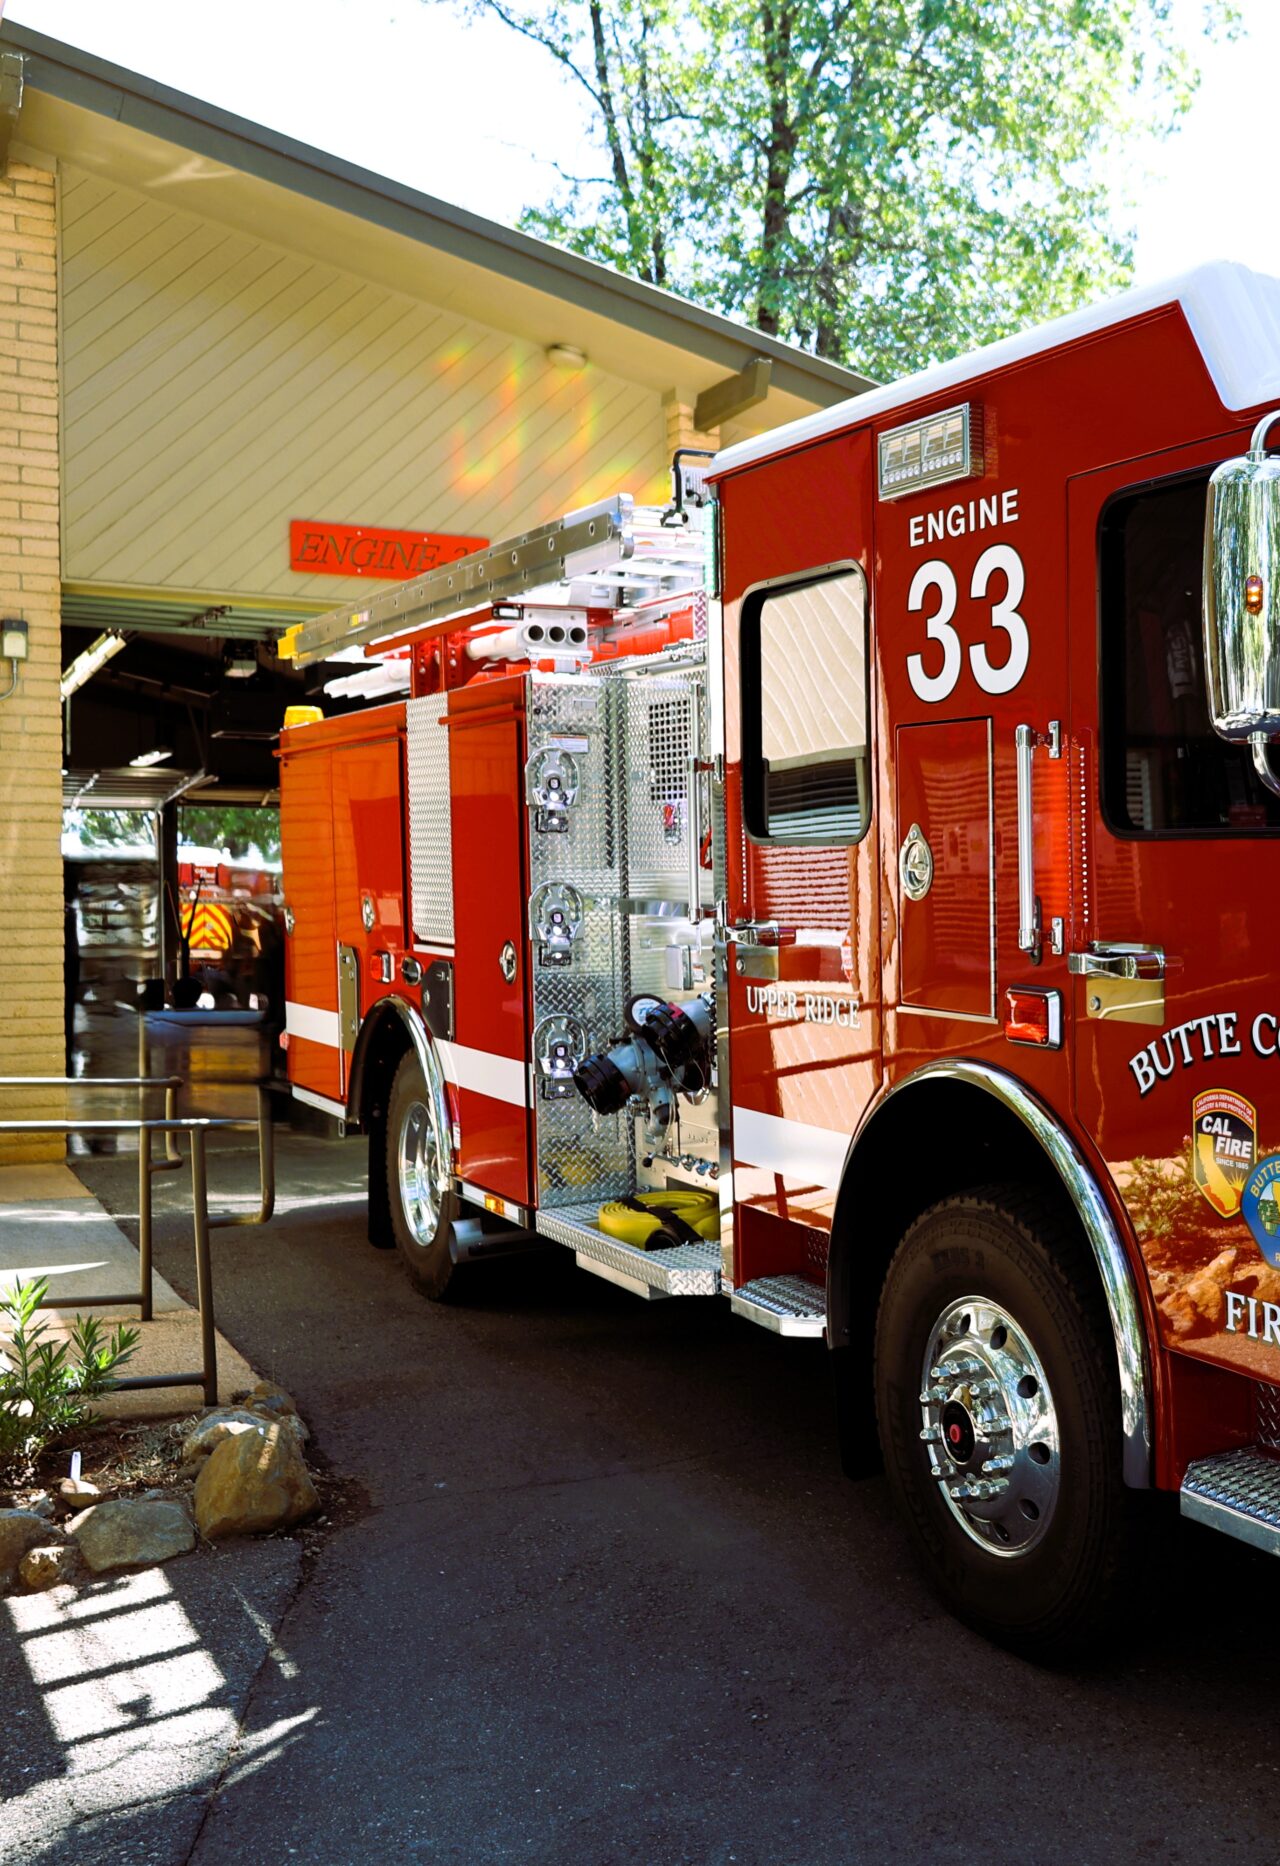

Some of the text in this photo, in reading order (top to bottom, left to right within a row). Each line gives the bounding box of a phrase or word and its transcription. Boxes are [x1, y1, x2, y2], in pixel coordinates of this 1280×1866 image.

[908, 488, 1020, 548] ENGINE
[905, 543, 1031, 704] 33
[746, 985, 861, 1030] UPPER RIDGE
[1129, 1011, 1242, 1096] BUTTE
[1202, 1115, 1232, 1136] CAL
[1215, 1136, 1252, 1159] FIRE
[1215, 1157, 1234, 1167] SINCE
